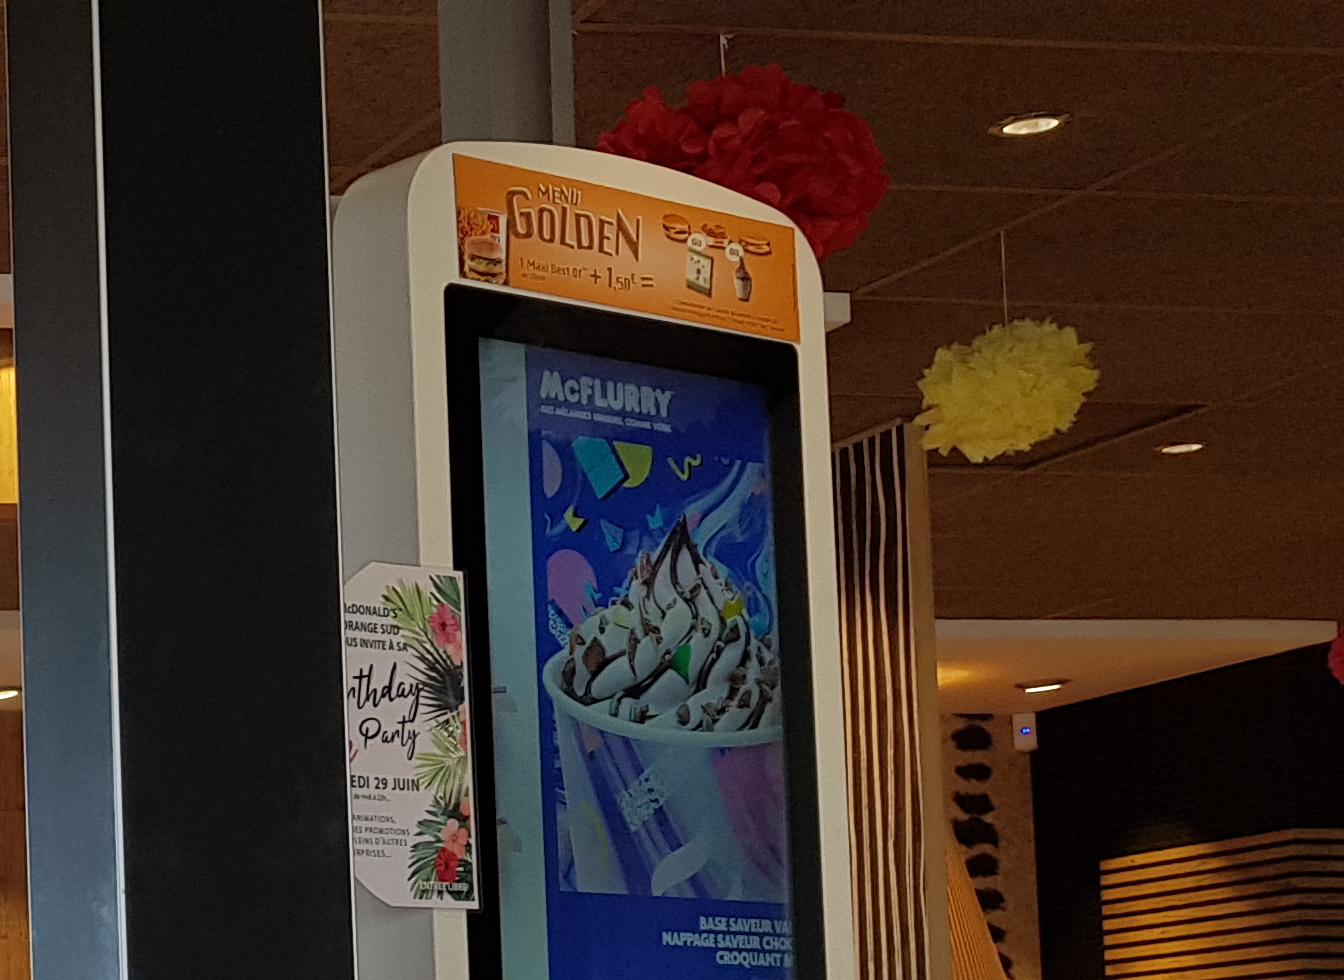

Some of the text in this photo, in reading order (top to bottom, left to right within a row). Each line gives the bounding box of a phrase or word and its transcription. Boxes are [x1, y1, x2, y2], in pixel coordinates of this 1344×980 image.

[537, 182, 583, 206] MENU
[505, 186, 643, 262] GOLDEN
[380, 623, 400, 636] SUD
[359, 638, 387, 650] INVITE
[396, 641, 409, 652] SA
[347, 661, 425, 724] rthday
[359, 714, 421, 761] Party
[351, 775, 421, 792] EDI 29 JUIN
[699, 916, 728, 931] BASE
[728, 917, 772, 933] SAVEUR
[661, 930, 716, 948] NAPPAGE
[716, 933, 761, 950] SAVEUR
[715, 950, 782, 969] CROQUANT
